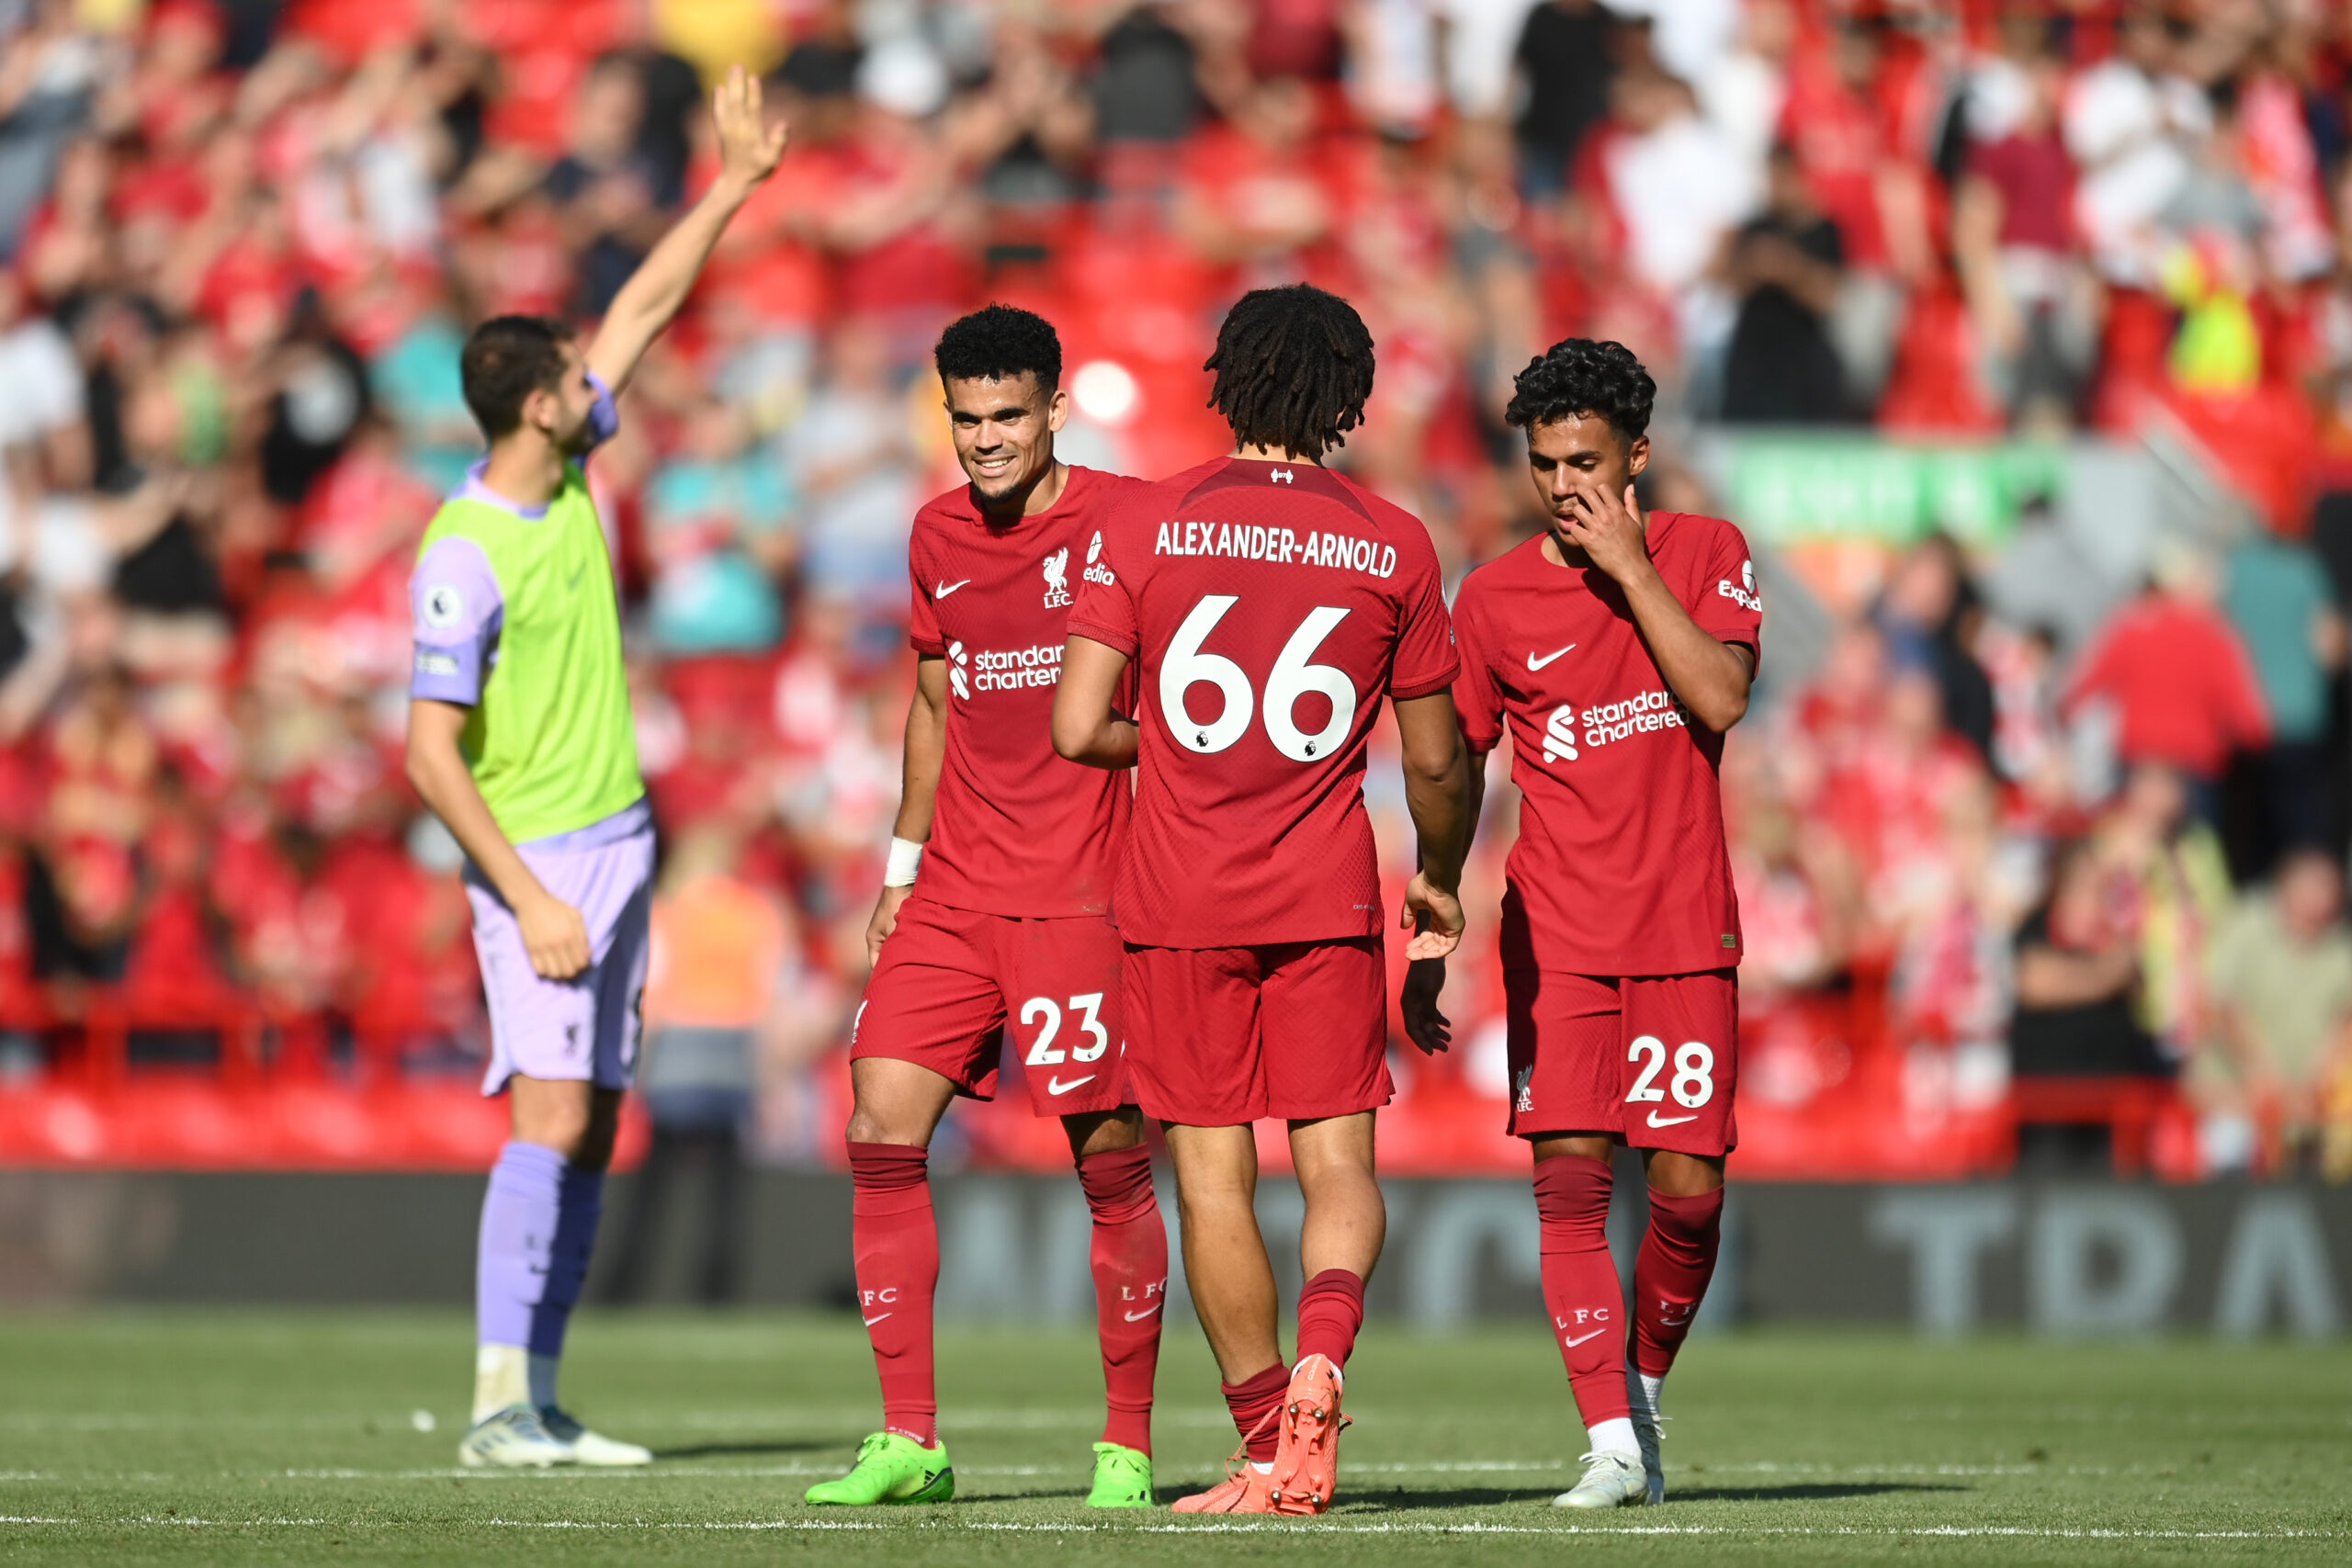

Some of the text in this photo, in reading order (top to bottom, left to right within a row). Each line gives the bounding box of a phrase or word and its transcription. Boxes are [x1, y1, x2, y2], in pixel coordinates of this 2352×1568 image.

[1155, 522, 1396, 580] ALEXANDER-ARNOLD
[975, 666, 1061, 691] charter
[1159, 593, 1357, 763] 66
[1020, 992, 1109, 1066] 23
[1624, 1035, 1714, 1109] 28
[857, 1287, 897, 1306] FC
